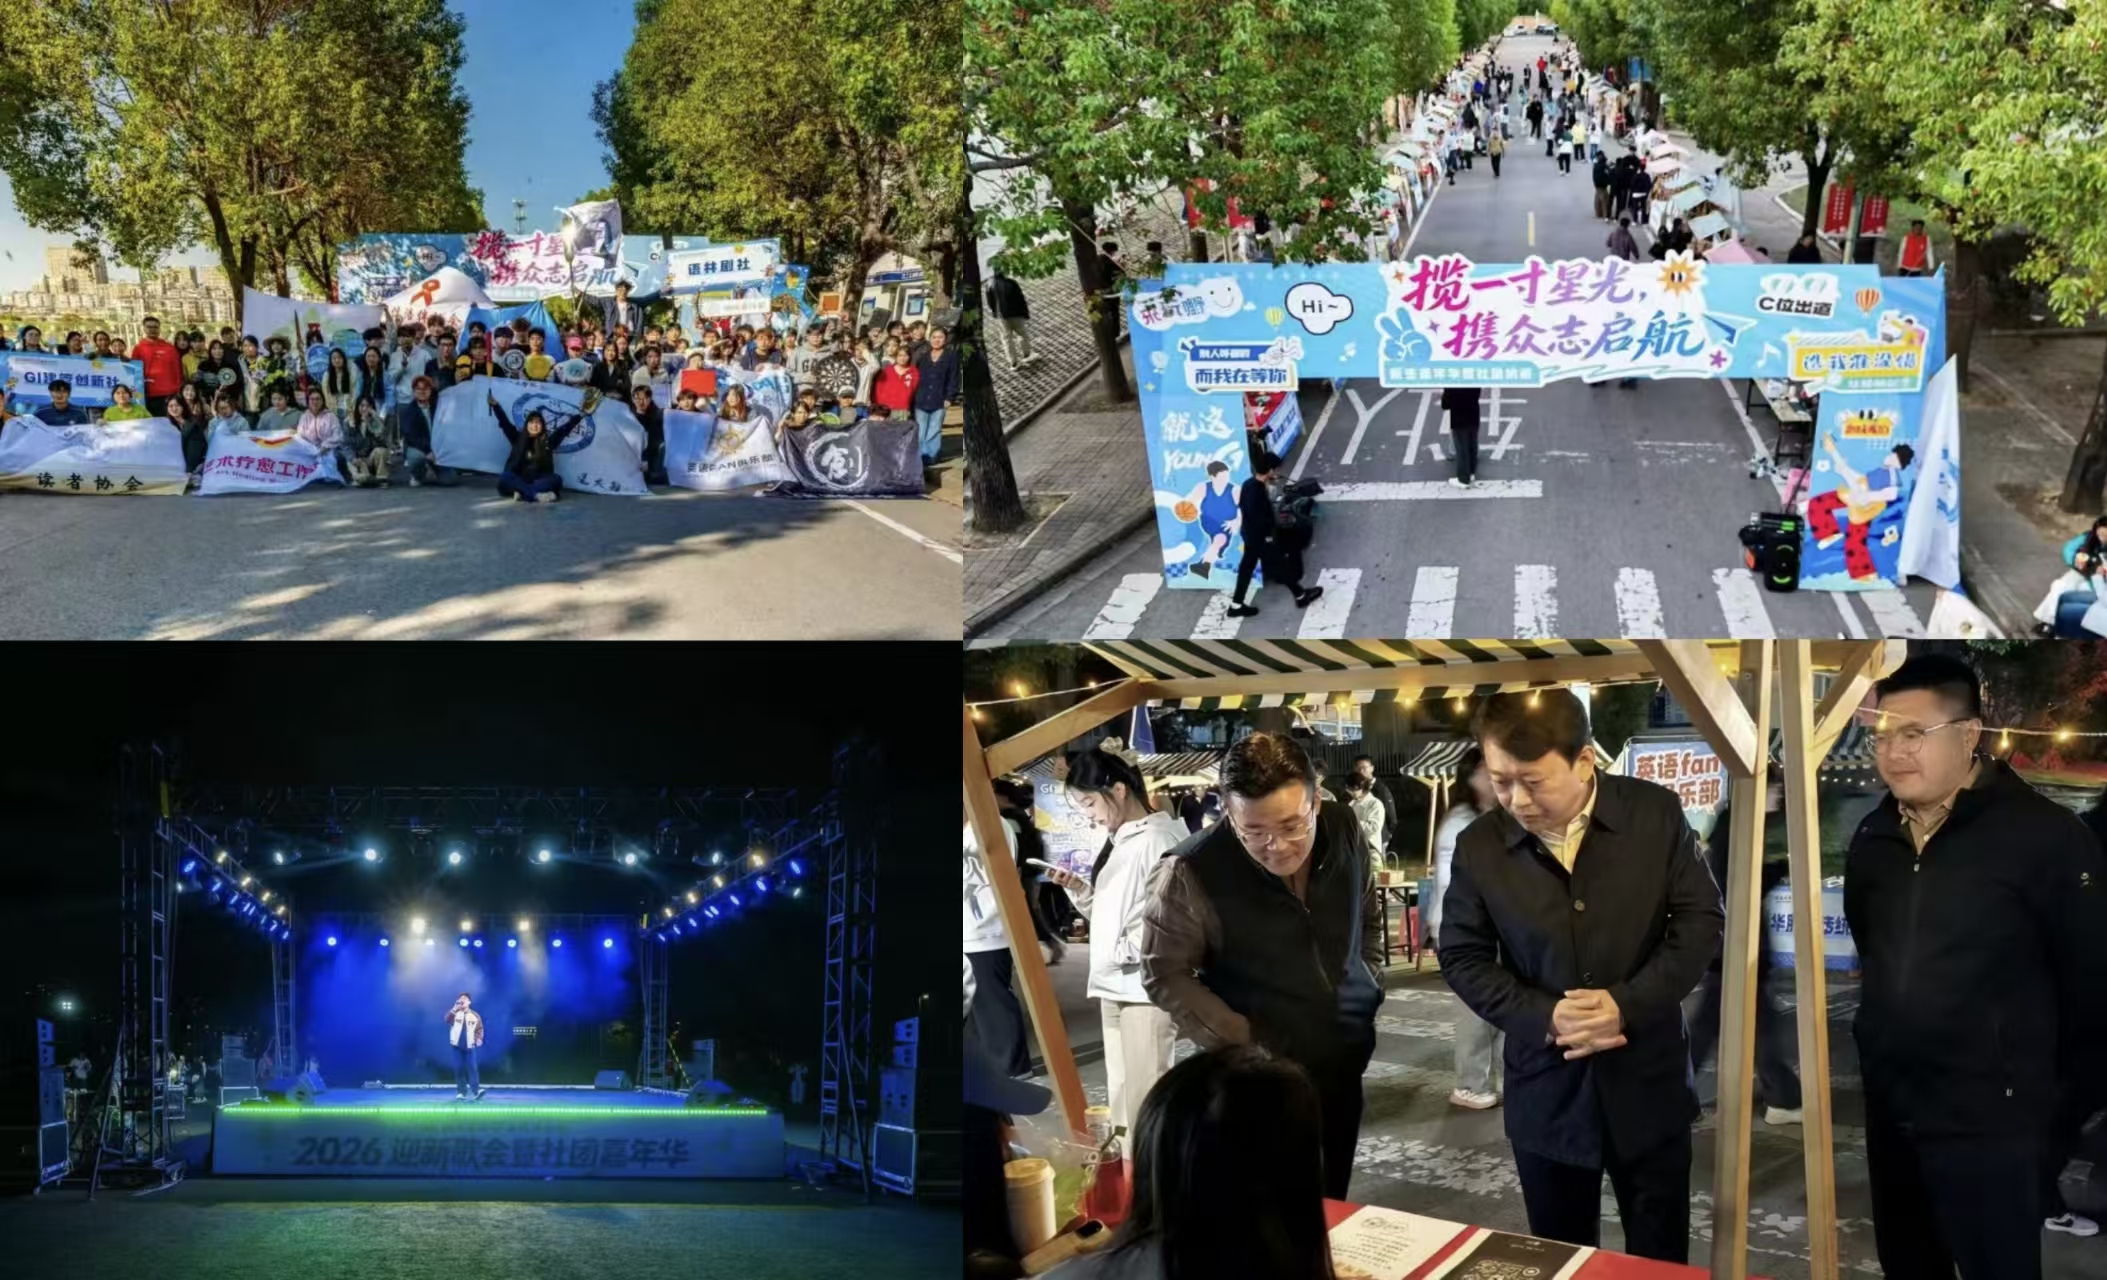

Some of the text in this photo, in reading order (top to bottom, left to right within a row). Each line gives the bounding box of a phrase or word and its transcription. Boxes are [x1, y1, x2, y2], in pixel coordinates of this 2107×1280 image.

[1759, 297, 1832, 316] C位出道
[1442, 309, 1705, 361] 携众志启航
[1195, 368, 1287, 384] 而我在等你
[1161, 404, 1234, 443] 就这
[36, 471, 144, 493] 读者协会
[1635, 752, 1720, 778] 英语fan
[292, 1136, 382, 1166] 2026
